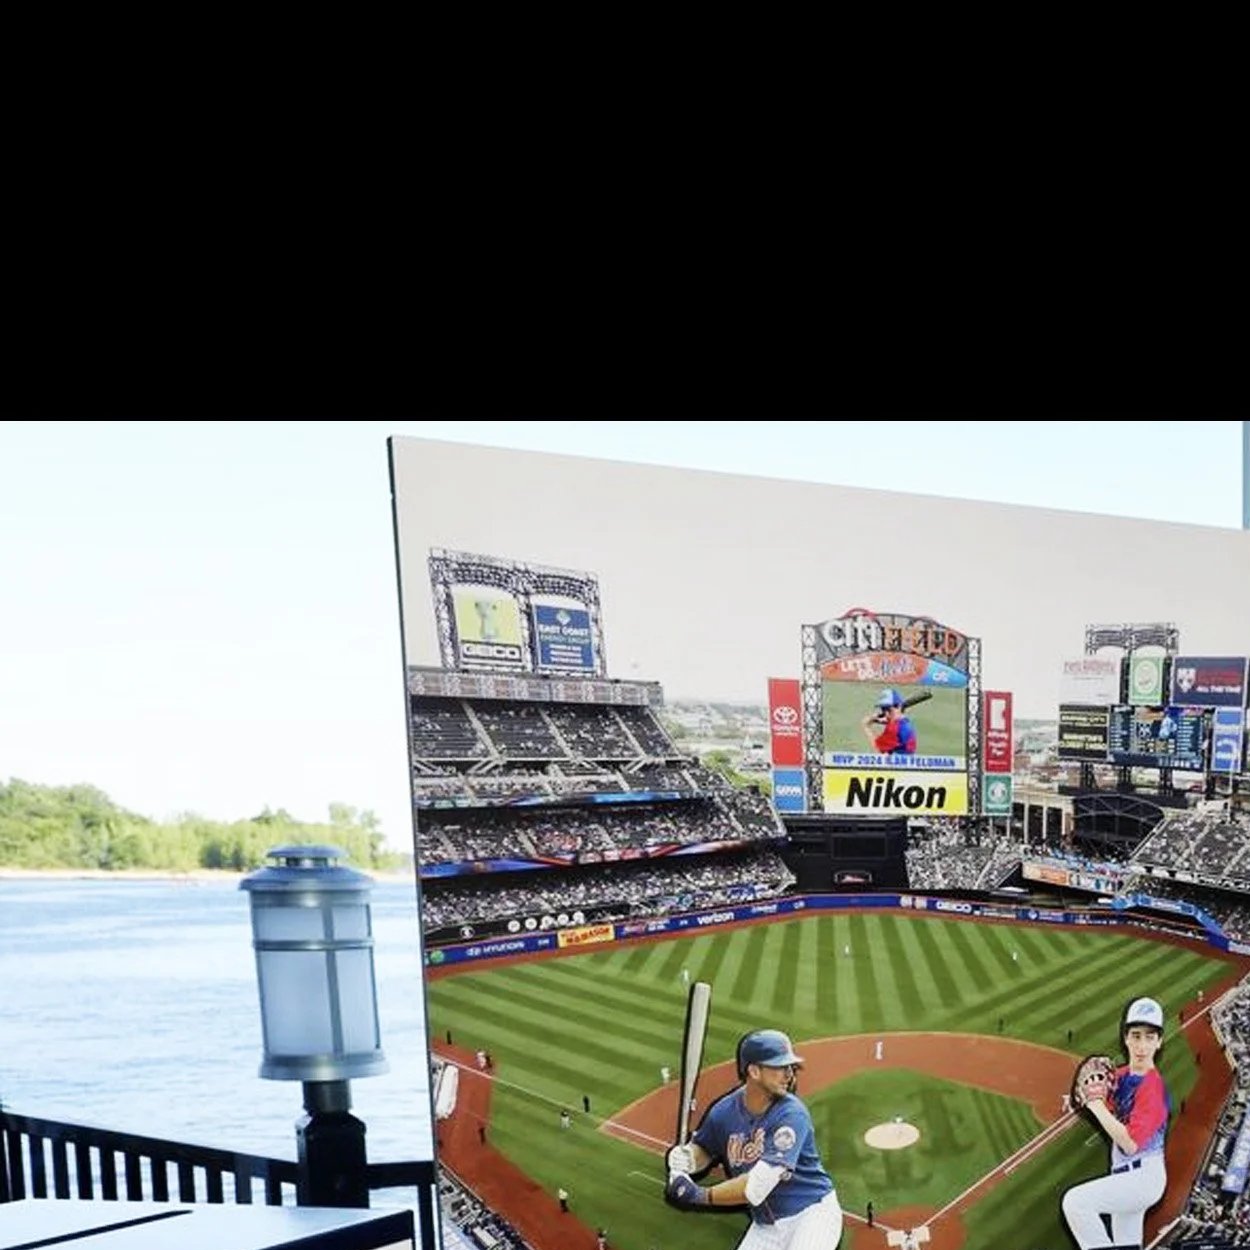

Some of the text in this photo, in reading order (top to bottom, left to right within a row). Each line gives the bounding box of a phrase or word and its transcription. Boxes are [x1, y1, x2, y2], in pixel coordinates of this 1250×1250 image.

[832, 754, 855, 764] MVP
[857, 755, 882, 765] 2024
[910, 757, 956, 767] FELDMAN
[845, 776, 947, 809] Nikon
[697, 911, 734, 925] verizon
